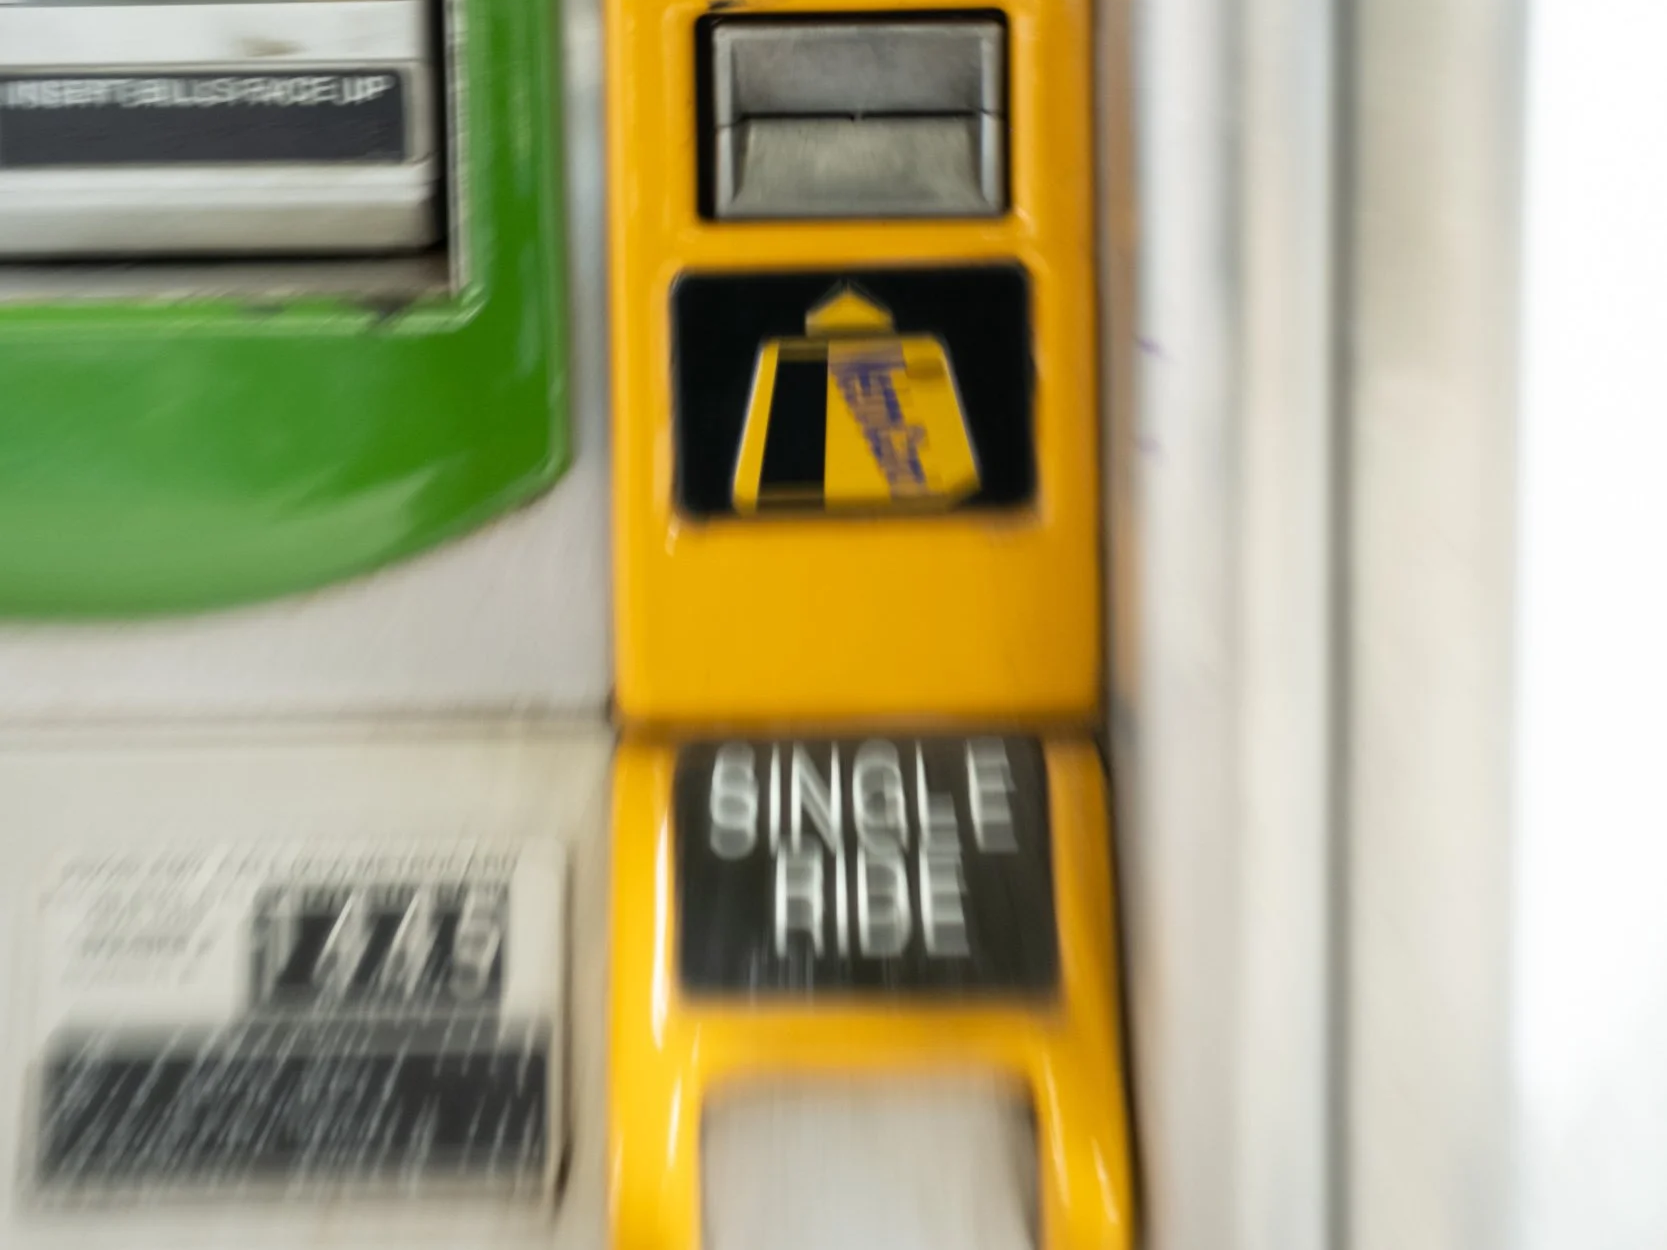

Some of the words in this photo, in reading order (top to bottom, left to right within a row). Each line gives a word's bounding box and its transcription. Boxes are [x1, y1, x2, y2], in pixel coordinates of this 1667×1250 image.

[337, 74, 397, 105] UP
[709, 736, 1018, 859] SINGLE
[775, 835, 970, 959] RIDE
